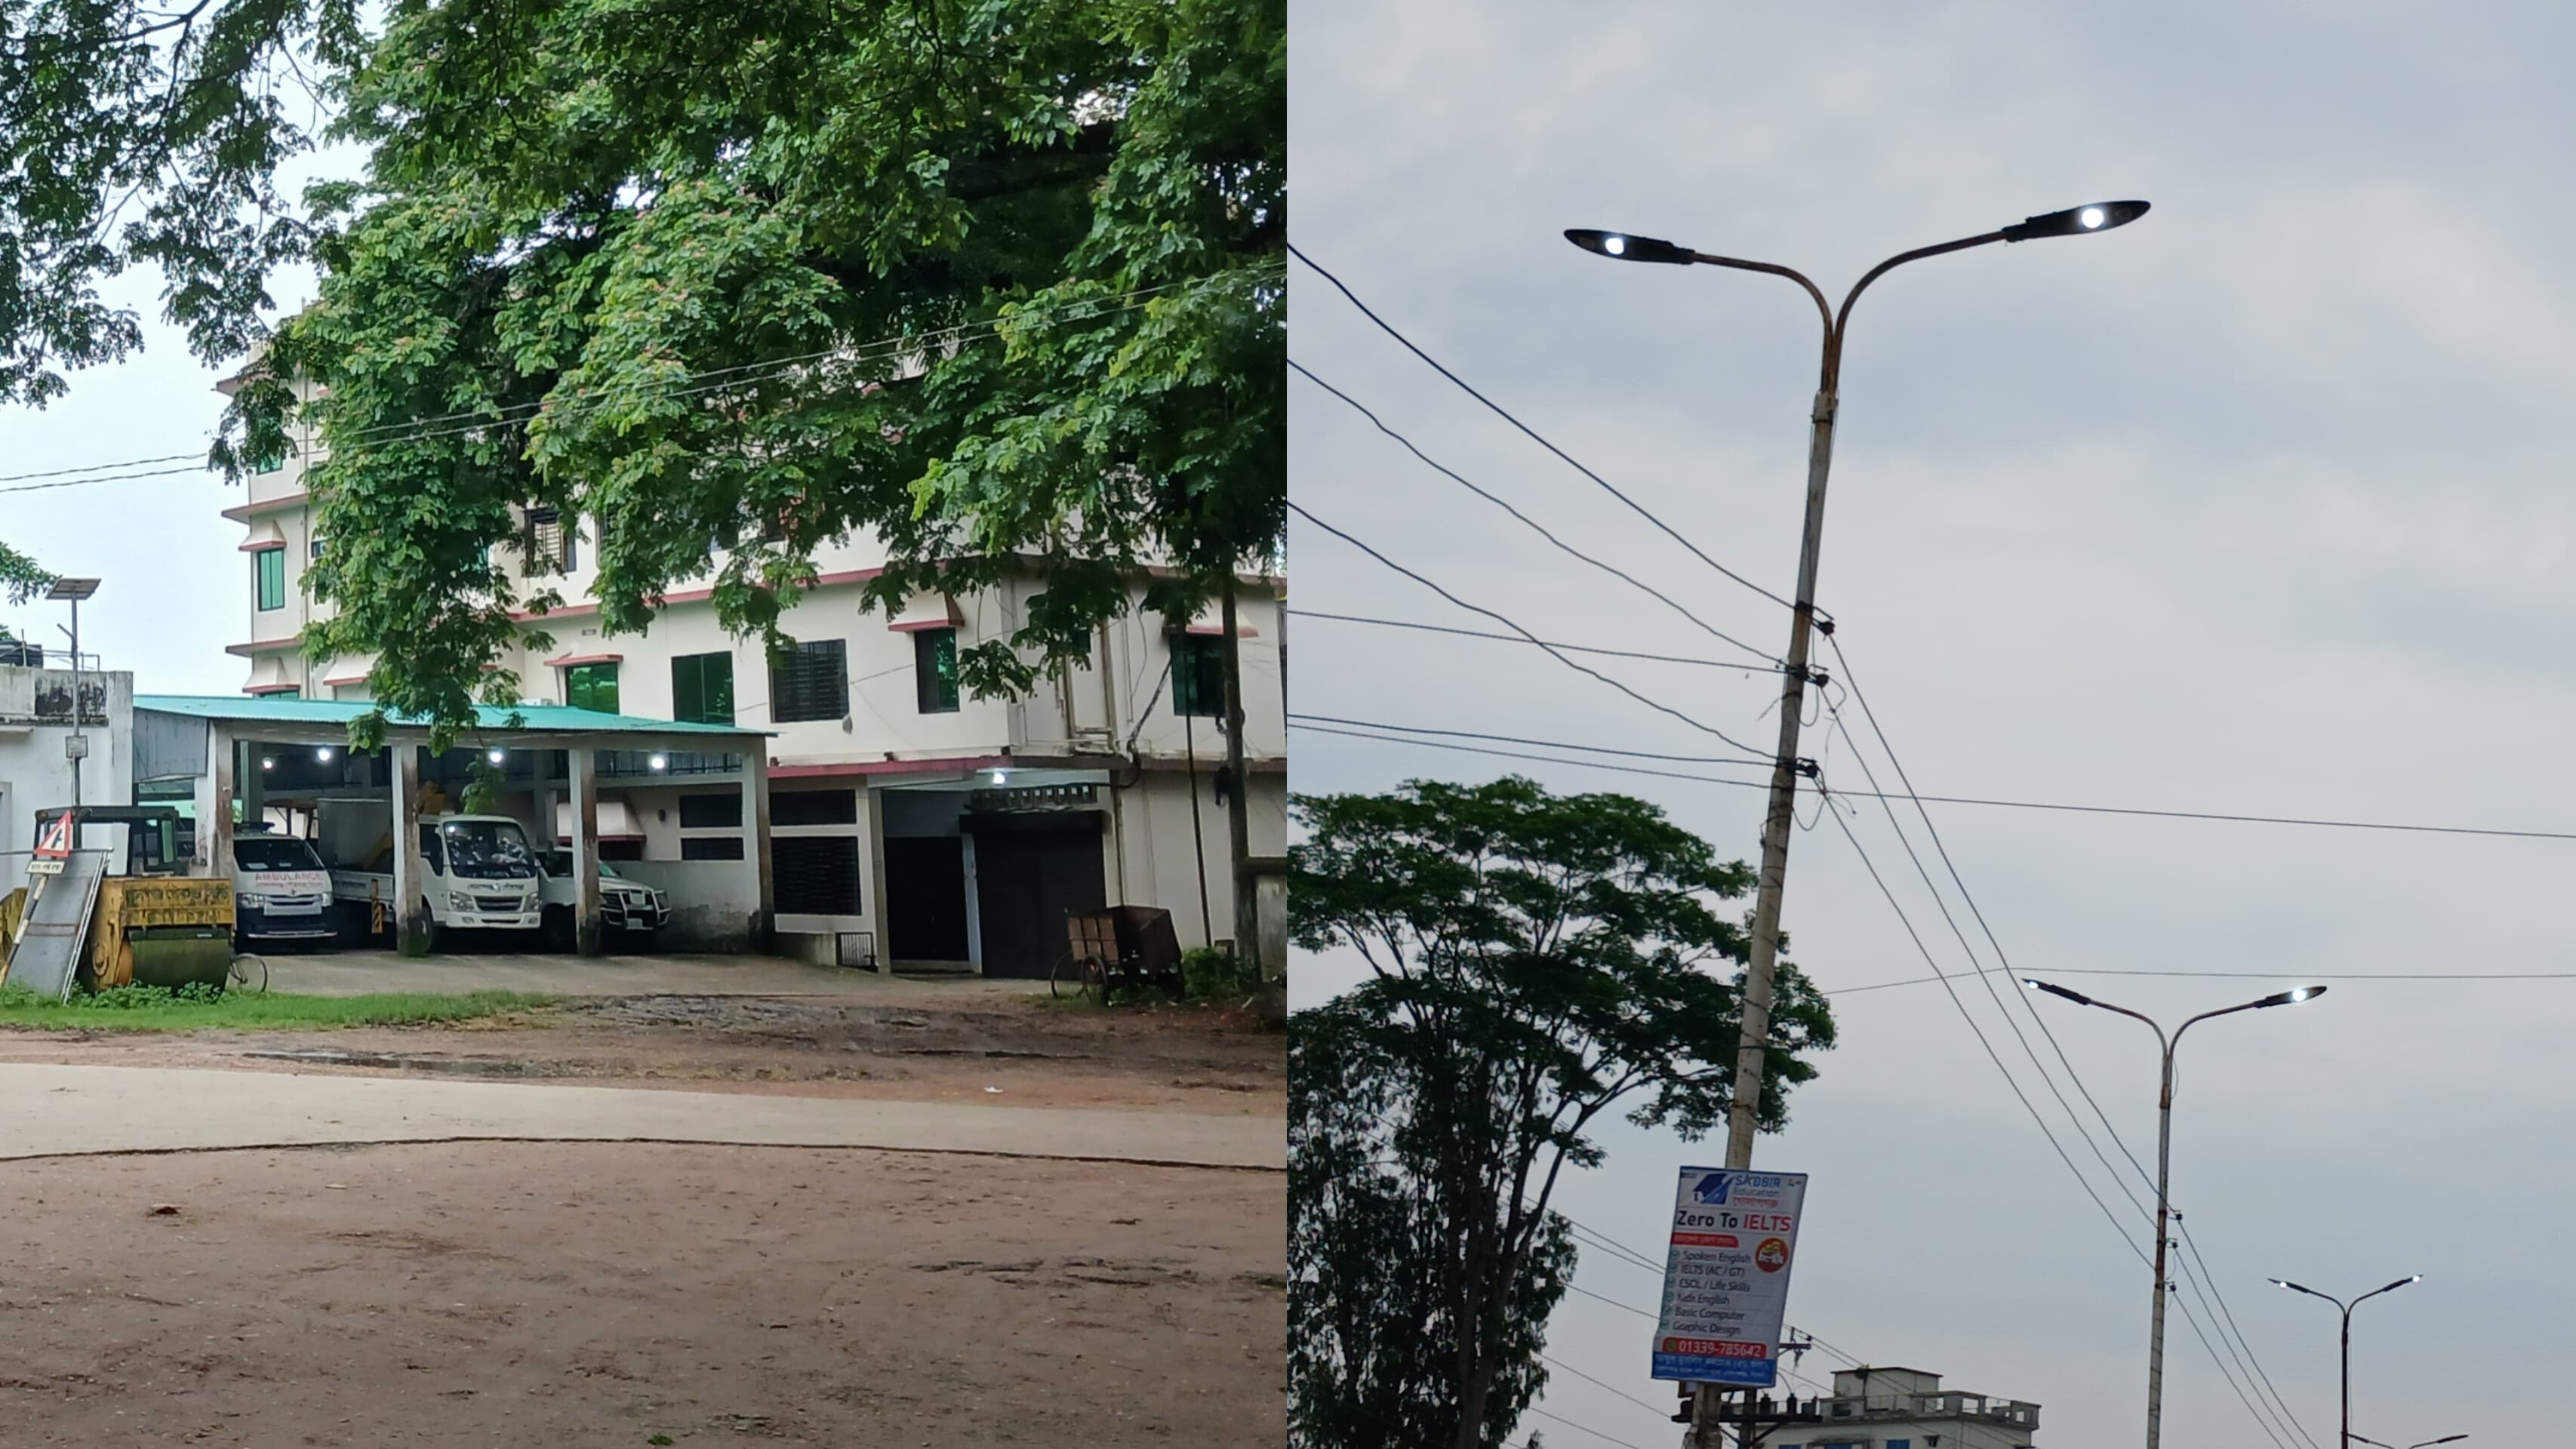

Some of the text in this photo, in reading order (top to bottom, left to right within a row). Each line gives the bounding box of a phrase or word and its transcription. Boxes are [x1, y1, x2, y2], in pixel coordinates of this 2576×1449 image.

[255, 872, 324, 881] AMBULANCE
[1677, 1211, 1793, 1232] Zero To IELTS
[1683, 1251, 1716, 1262] Spoken
[1719, 1252, 1752, 1265] English
[1680, 1265, 1703, 1275] IELTS
[1710, 1280, 1726, 1290] Life
[1697, 1294, 1730, 1306] English
[1675, 1306, 1745, 1321] Basic Computer
[1673, 1321, 1740, 1337] Graphic Design
[1679, 1340, 1762, 1358] 01339-785642
